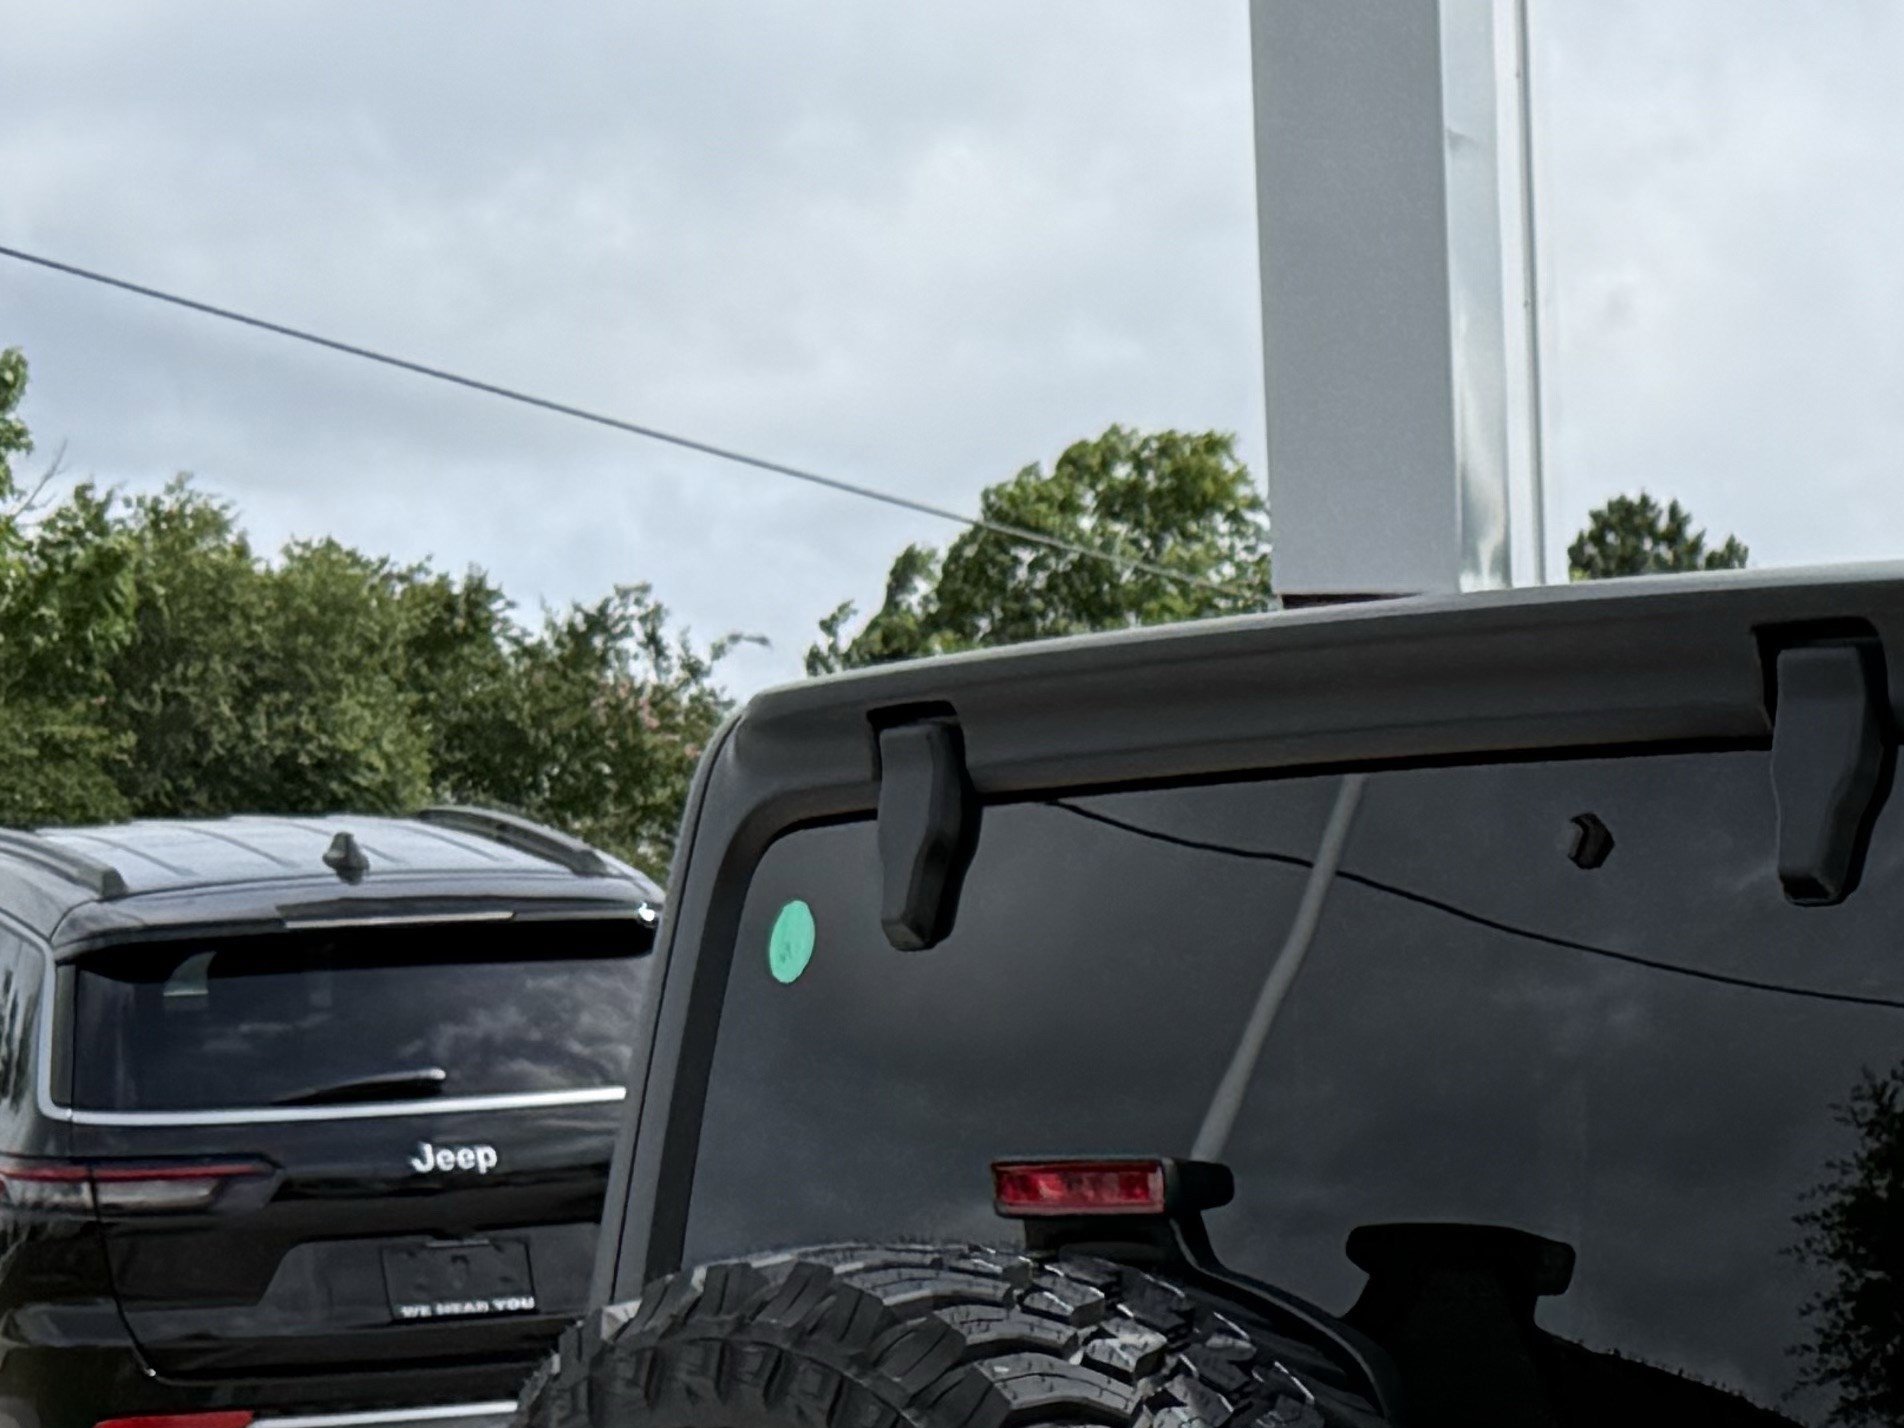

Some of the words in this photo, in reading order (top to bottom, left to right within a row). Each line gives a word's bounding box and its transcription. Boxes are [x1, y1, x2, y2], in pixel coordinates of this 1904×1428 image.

[410, 1142, 498, 1174] Jeep
[400, 1304, 432, 1318] WE
[492, 1296, 535, 1311] YOU
